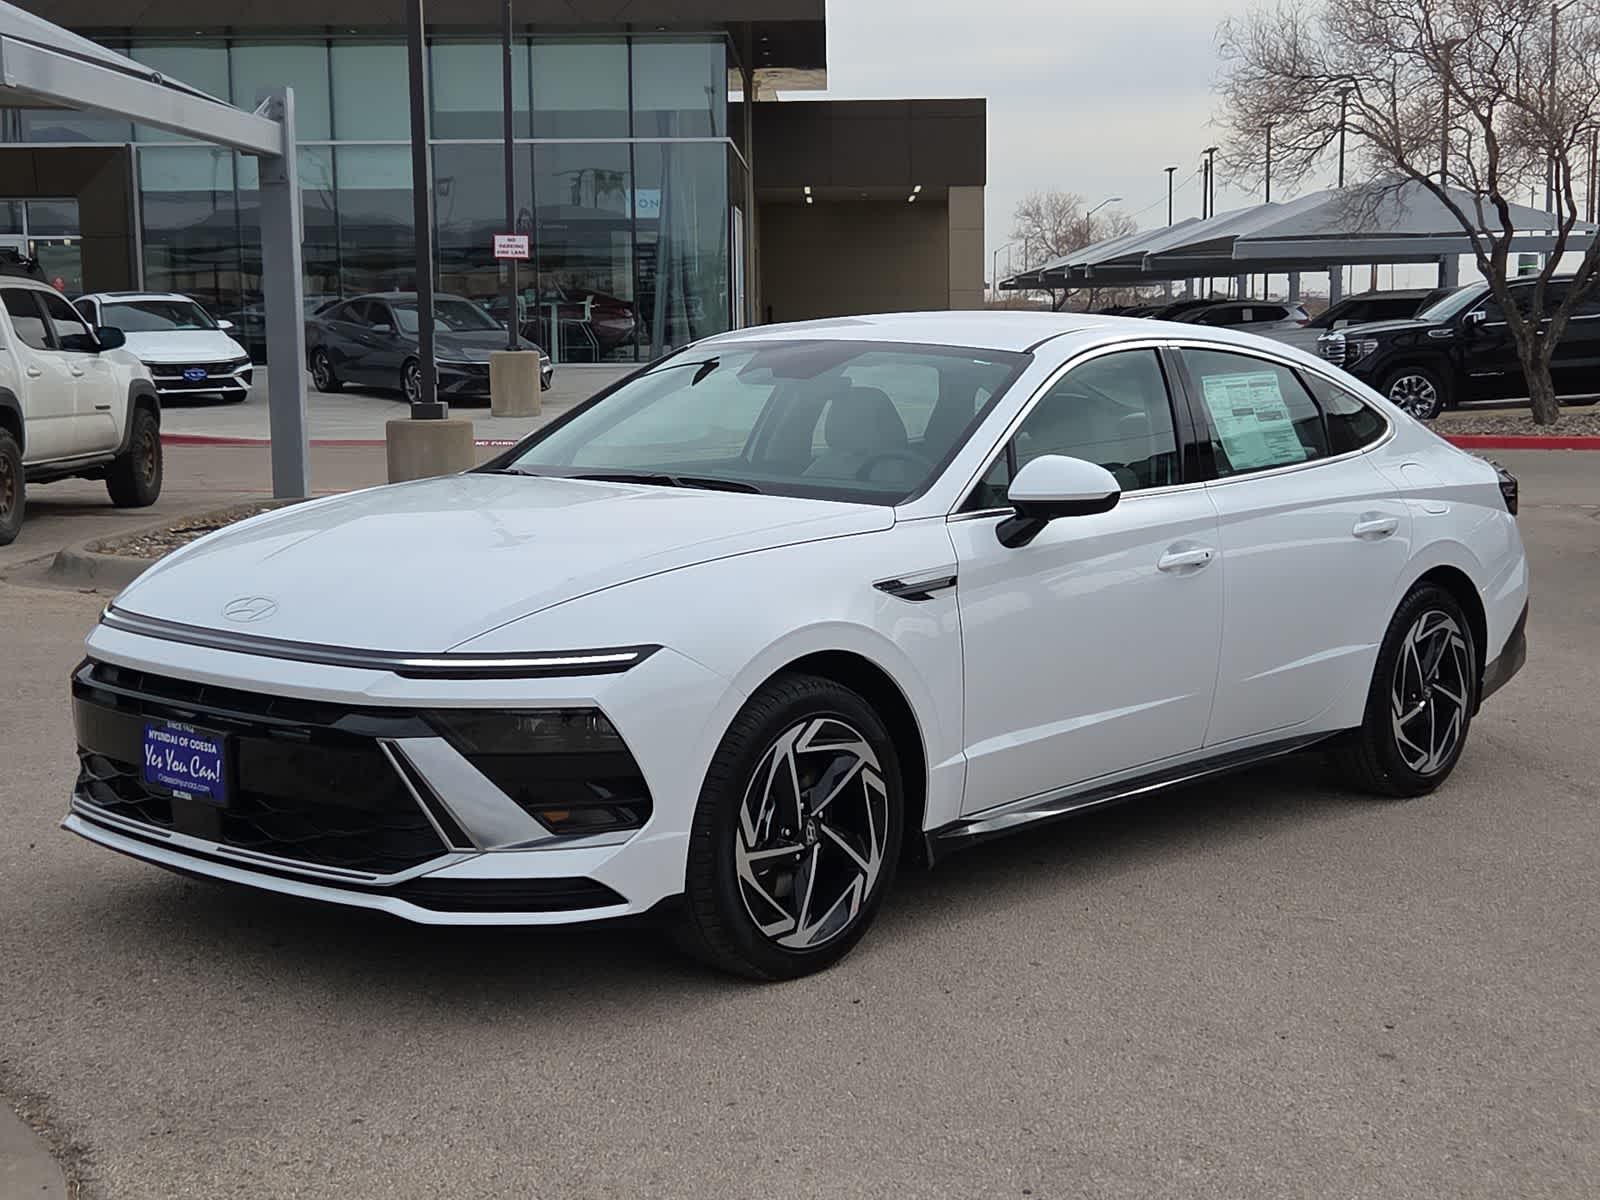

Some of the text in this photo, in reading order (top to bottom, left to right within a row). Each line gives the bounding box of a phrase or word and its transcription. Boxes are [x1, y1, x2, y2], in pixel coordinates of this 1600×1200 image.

[148, 729, 217, 754] HYUNDAI OF ODESSA
[145, 743, 221, 783] Yes You Can!
